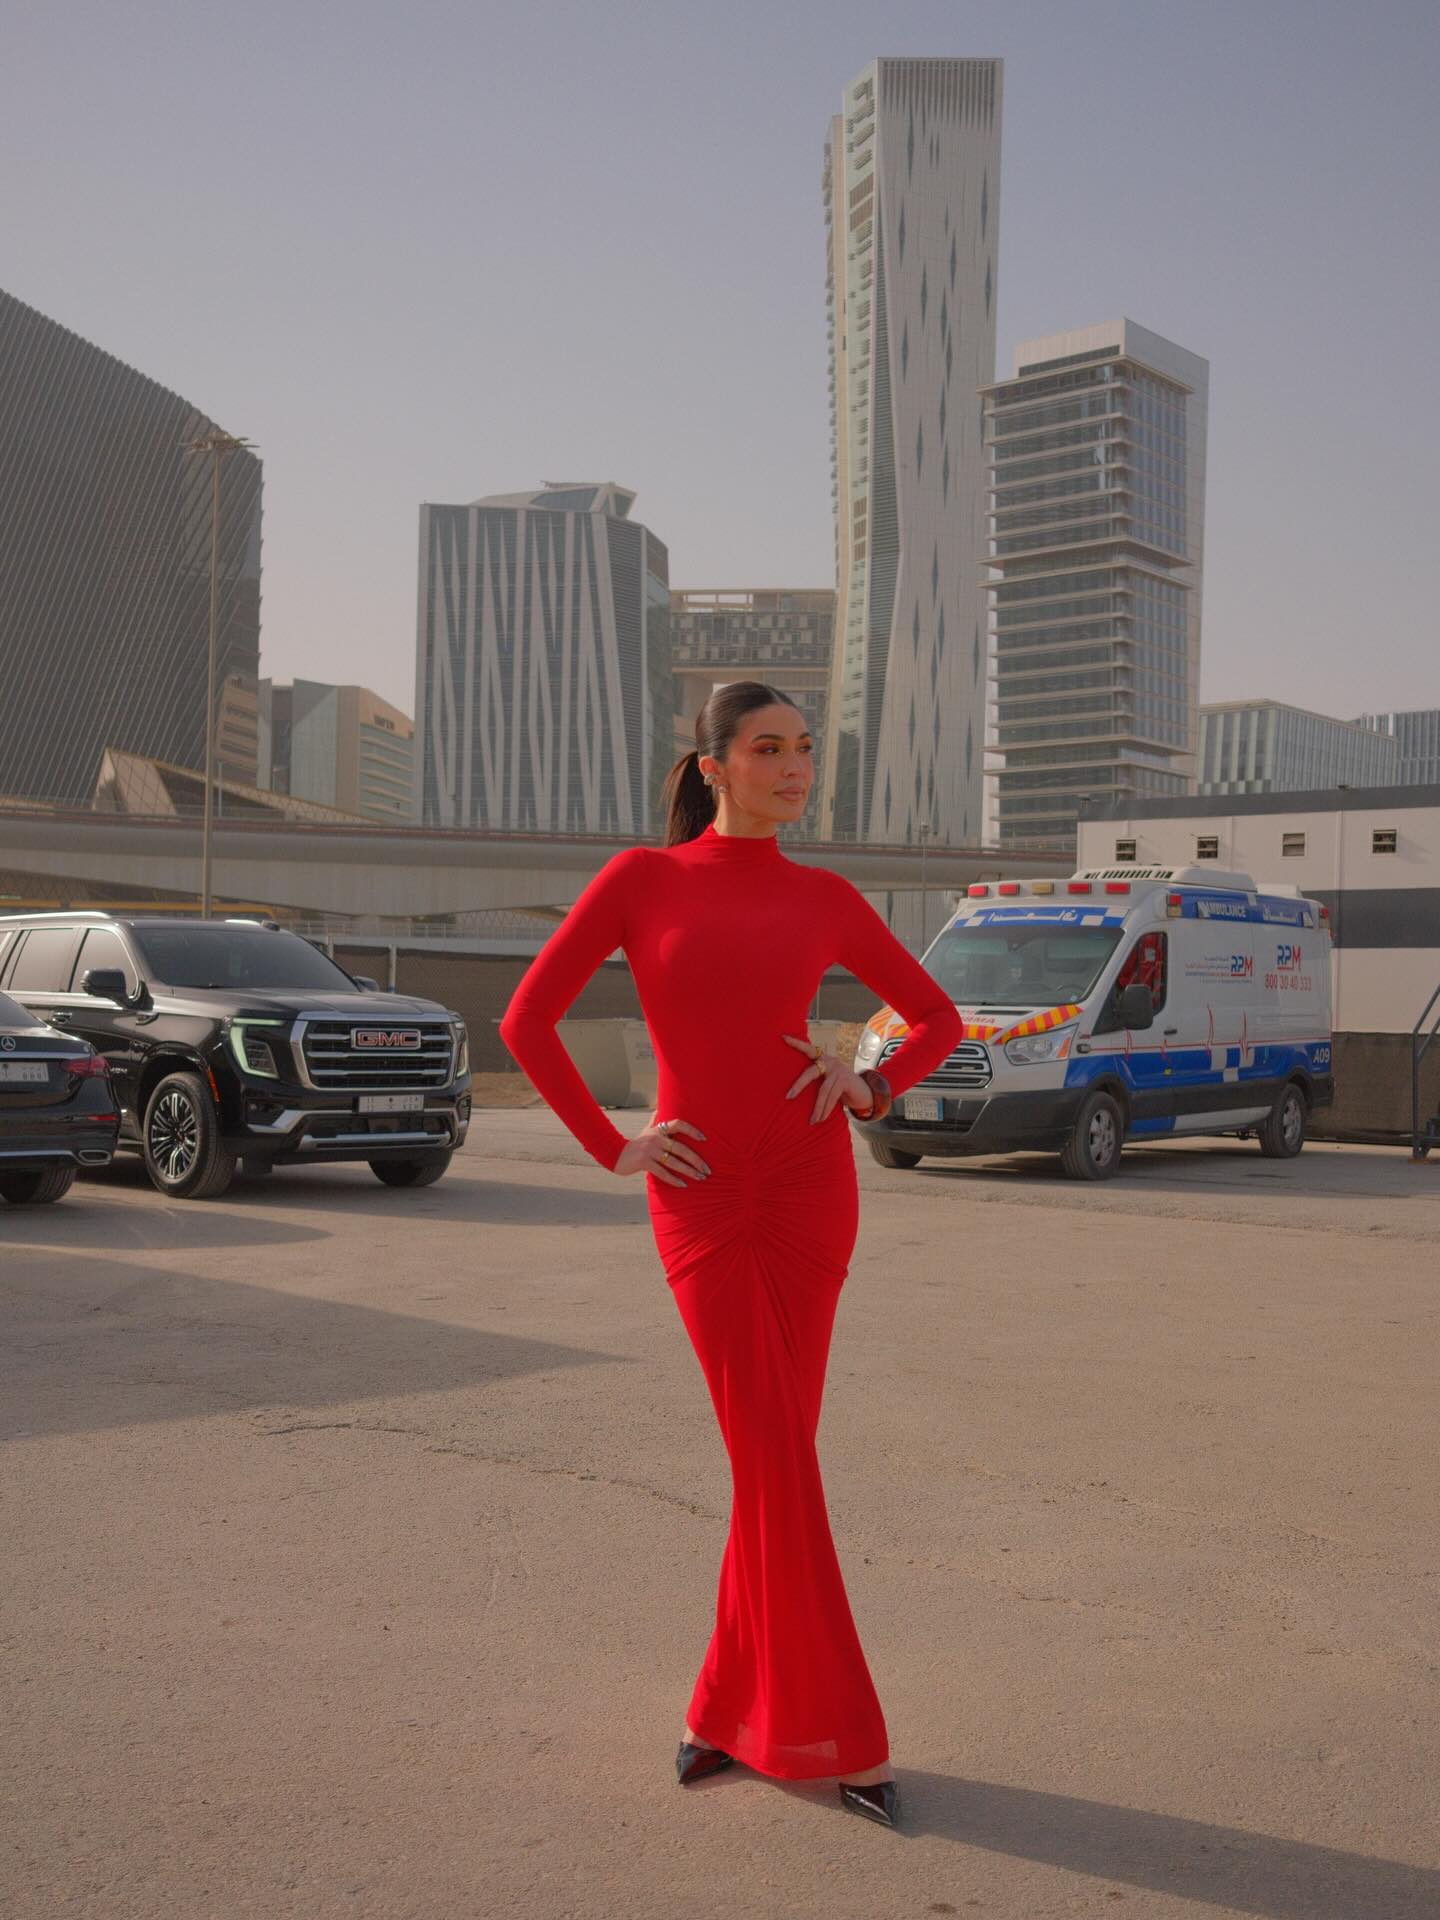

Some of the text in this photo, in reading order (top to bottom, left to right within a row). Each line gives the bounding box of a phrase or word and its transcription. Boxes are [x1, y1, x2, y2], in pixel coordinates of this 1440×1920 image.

[1208, 902, 1247, 918] AMBULANCE
[1277, 945, 1301, 970] RPM
[1230, 956, 1252, 976] RPM
[1264, 973, 1278, 989] 800
[357, 1032, 418, 1046] GMC
[1313, 1048, 1330, 1063] A09
